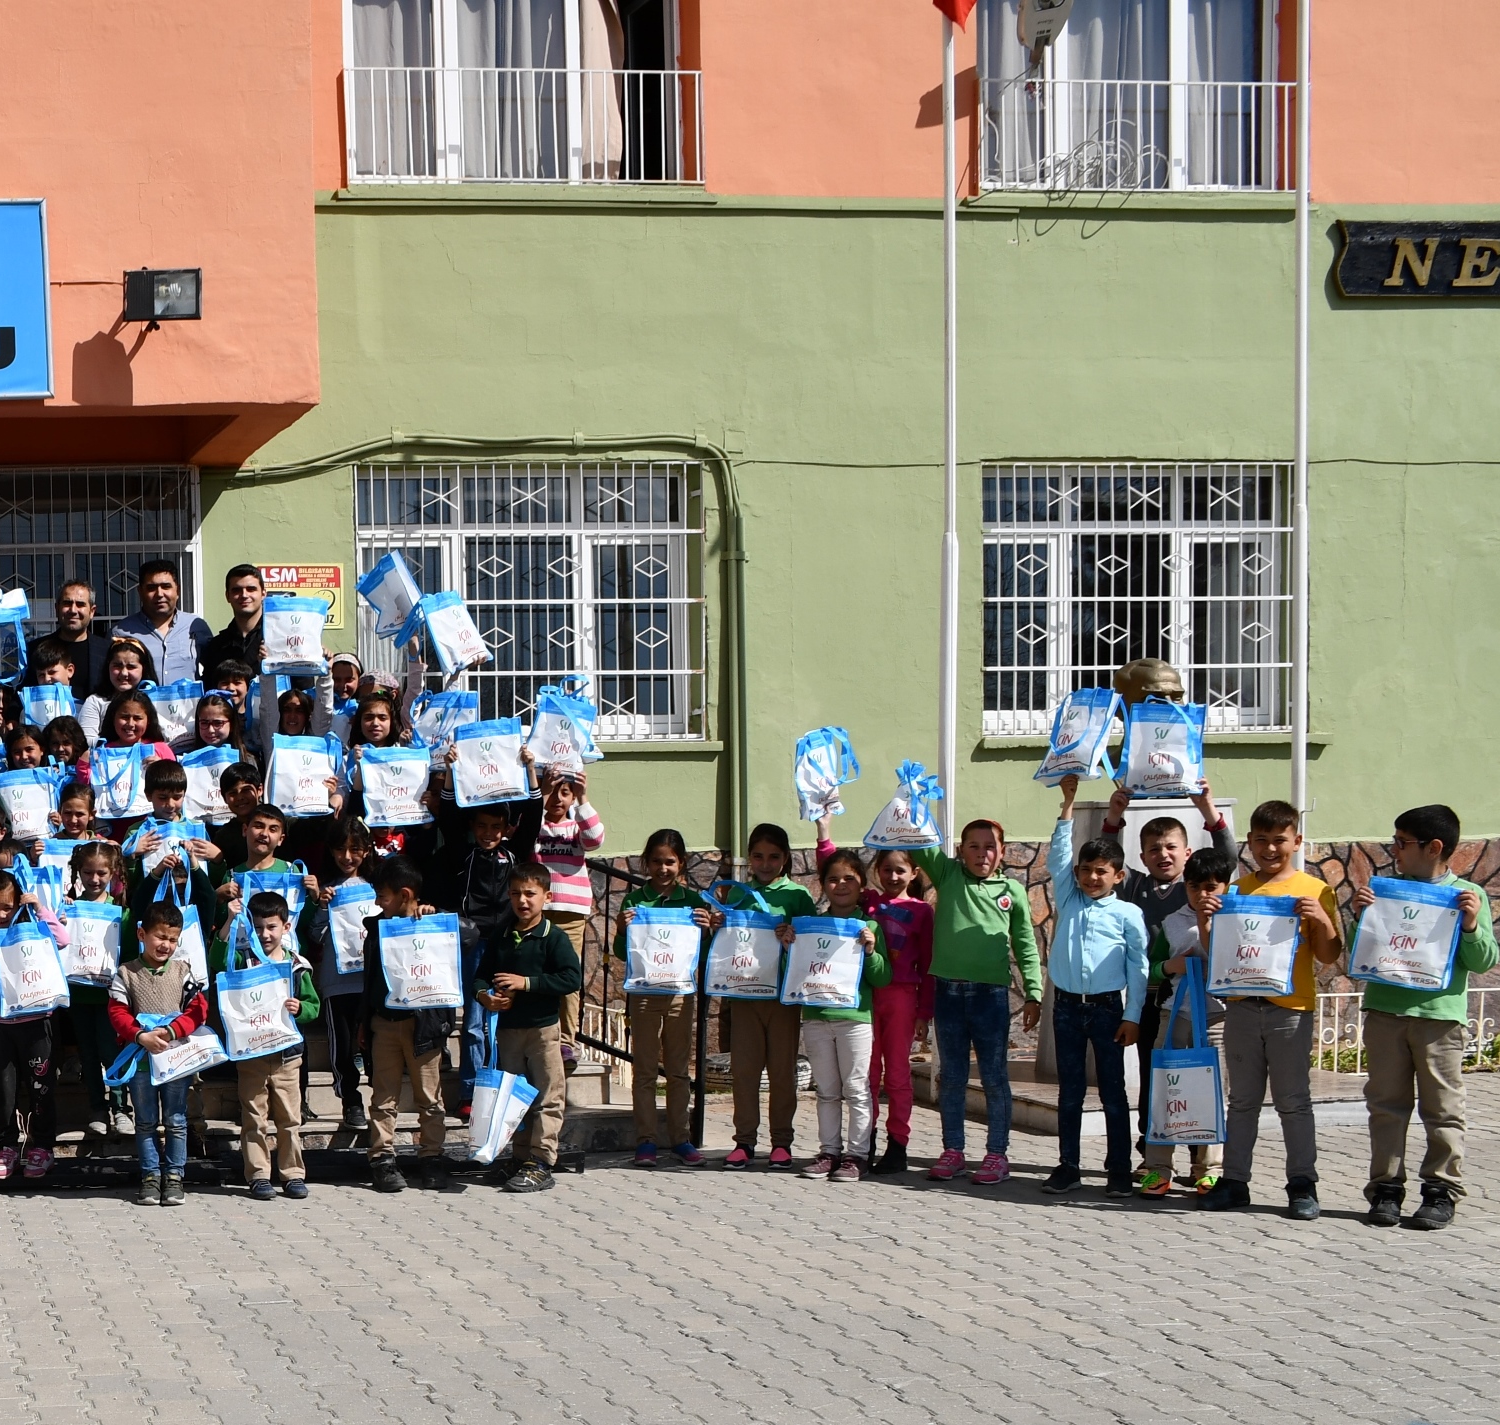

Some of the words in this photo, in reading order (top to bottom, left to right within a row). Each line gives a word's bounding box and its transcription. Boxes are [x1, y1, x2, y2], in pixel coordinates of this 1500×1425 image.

[290, 615, 301, 625] SU
[287, 636, 304, 649] İÇİN
[45, 704, 54, 714] SU
[168, 704, 178, 715] SU
[560, 720, 571, 730] SU
[1155, 728, 1169, 739] SU
[480, 742, 492, 752] SU
[551, 741, 570, 755] İÇİN
[302, 755, 312, 765] SU
[1148, 752, 1171, 768] İÇİN
[211, 769, 219, 779] SU
[390, 766, 402, 776] SU
[479, 764, 498, 778] İÇİN
[12, 790, 23, 800] SU
[389, 787, 408, 799] İÇİN
[358, 905, 369, 916] SU
[1402, 906, 1420, 919] SU
[83, 922, 94, 932] SU
[1244, 919, 1260, 931] SU
[658, 929, 670, 939] SU
[739, 931, 751, 943] SU
[412, 939, 425, 951] SU
[817, 938, 831, 949] SU
[1389, 933, 1417, 950] İÇİN
[21, 945, 32, 957] SU
[79, 945, 97, 959] İÇİN
[1236, 945, 1260, 961] İÇİN
[654, 952, 674, 966] İÇİN
[732, 955, 753, 969] İÇİN
[411, 964, 431, 980] İÇİN
[809, 961, 831, 976] İÇİN
[22, 969, 42, 986] İÇİN
[250, 991, 262, 1003] SU
[250, 1013, 270, 1030] İÇİN
[1167, 1074, 1179, 1086] SU
[1167, 1100, 1187, 1116] İÇİN
